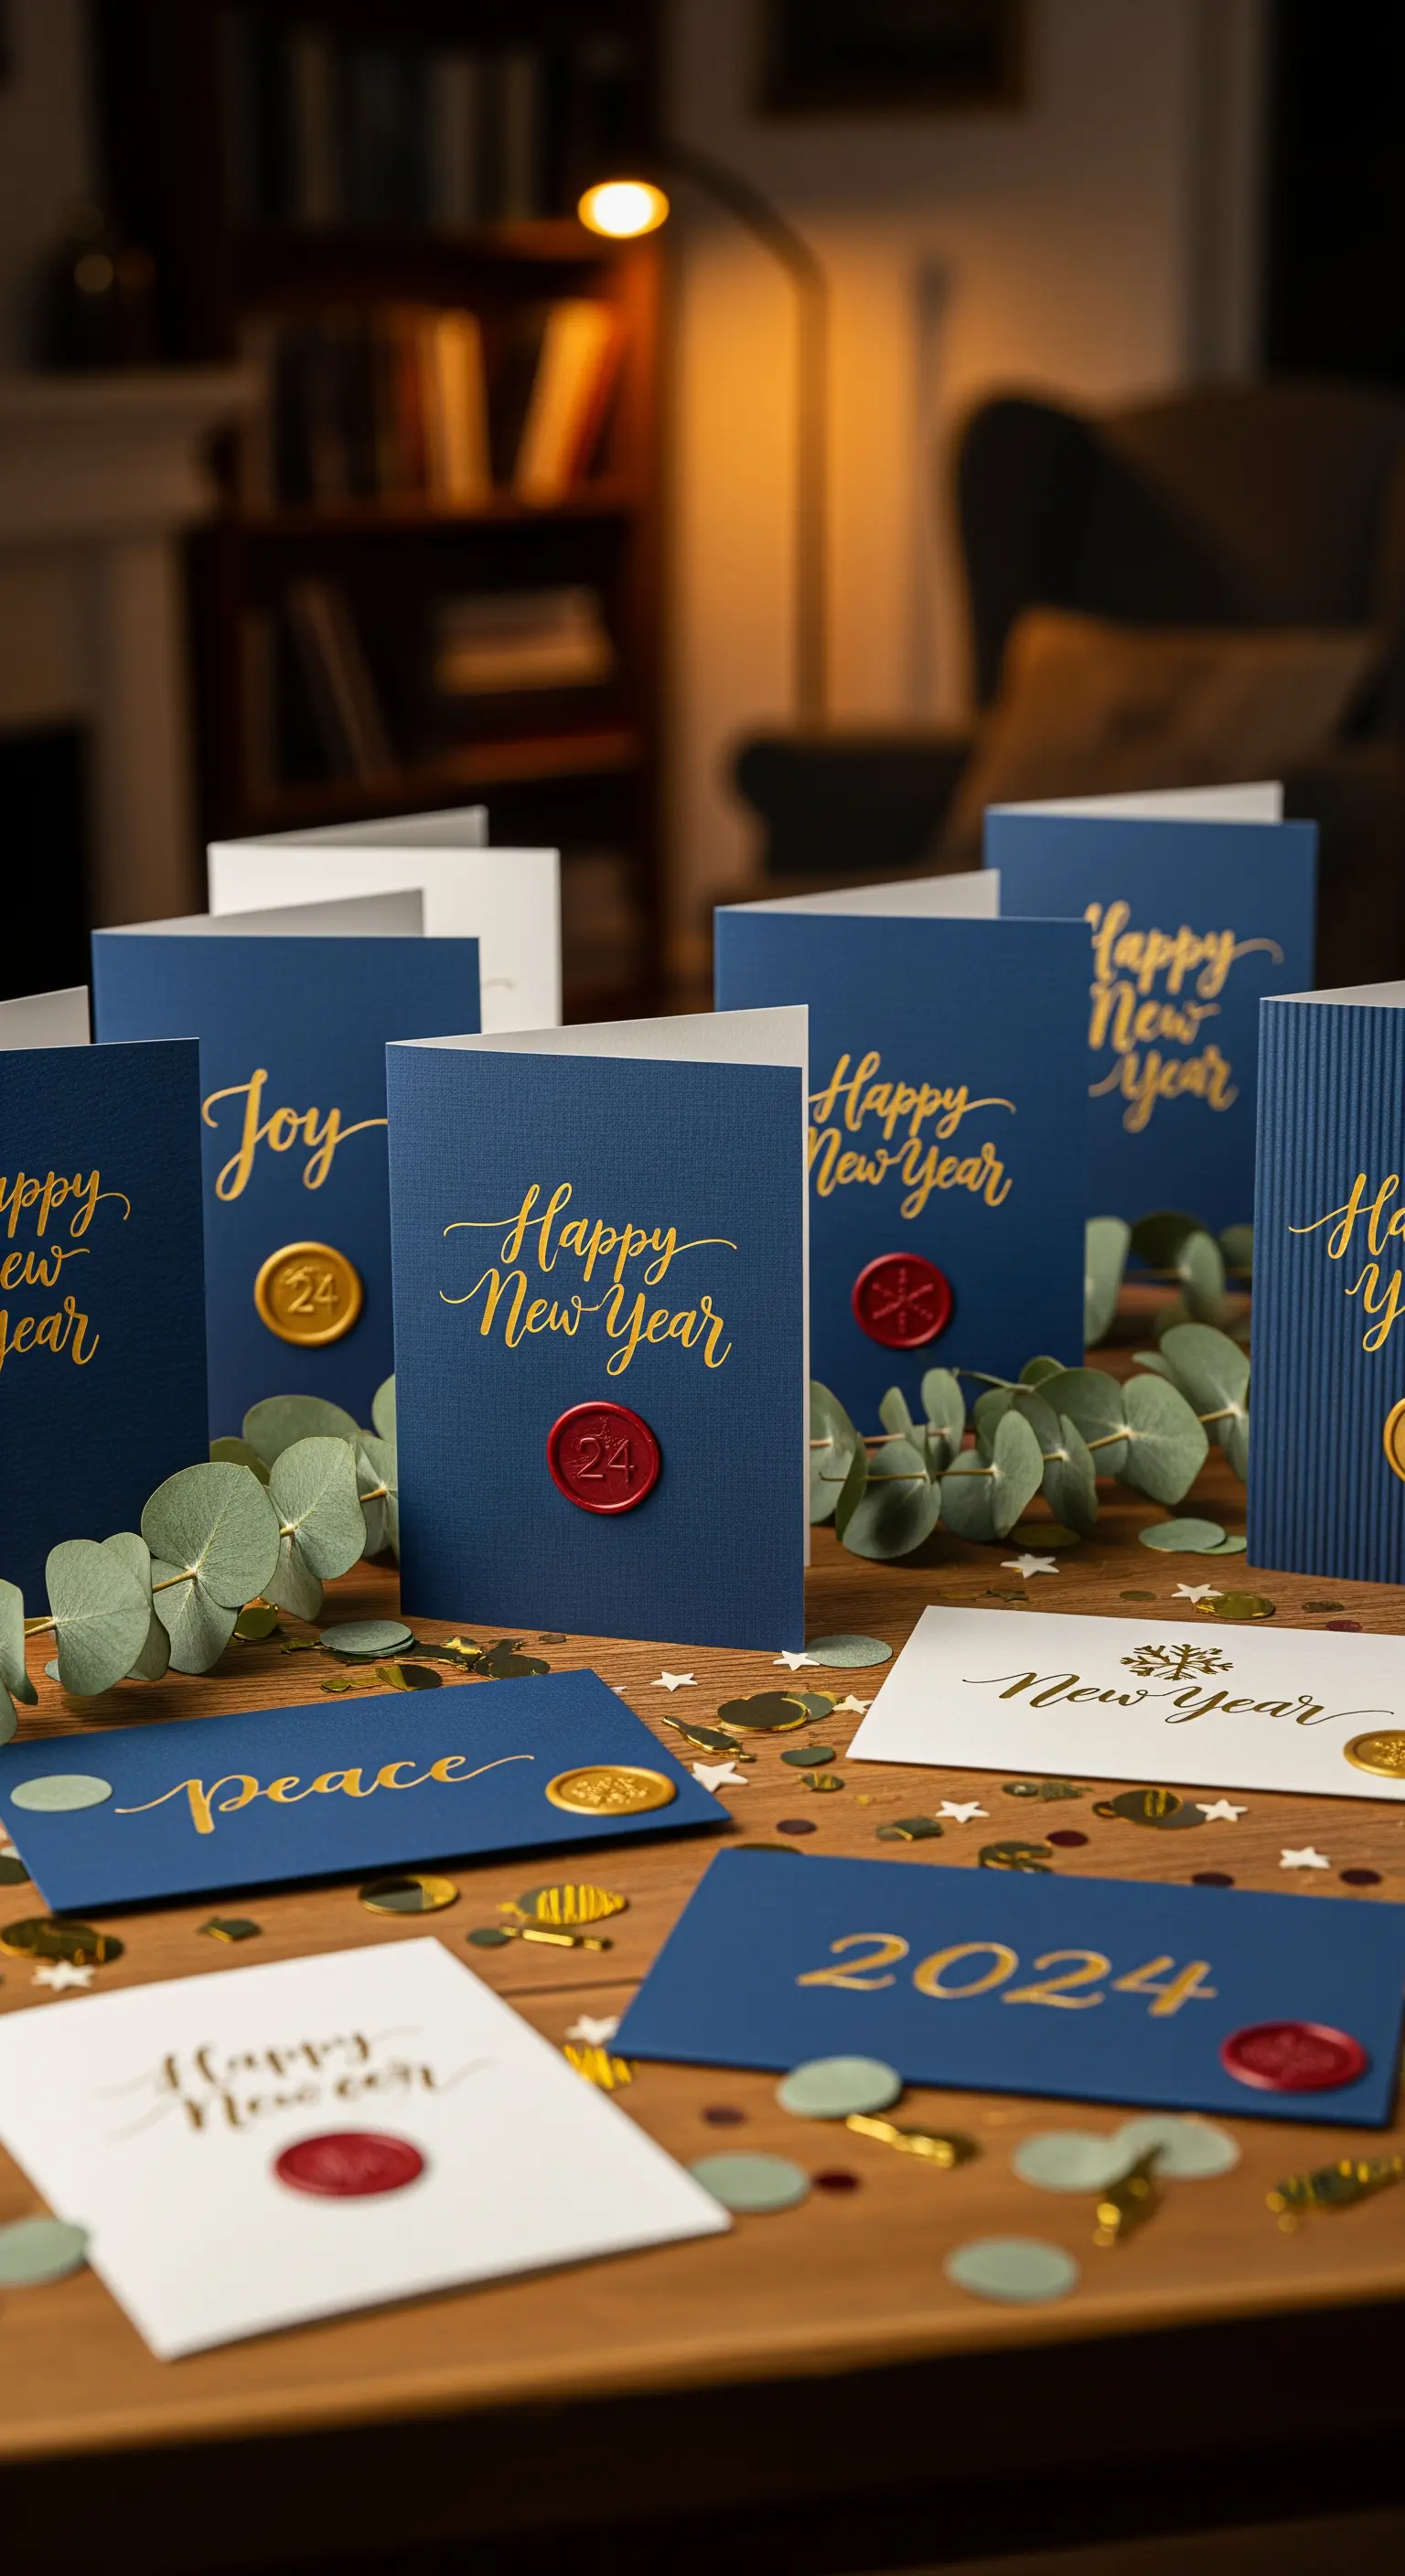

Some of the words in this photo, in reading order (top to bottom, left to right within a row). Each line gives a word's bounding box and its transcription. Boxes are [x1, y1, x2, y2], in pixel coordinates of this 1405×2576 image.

[1089, 980, 1221, 1052] New
[809, 1051, 1016, 1140] Happy
[1089, 1044, 1239, 1133] Year
[202, 1068, 389, 1201] Joy
[809, 1126, 894, 1197] New
[894, 1137, 1013, 1219] Year
[444, 1183, 737, 1285] Happy
[285, 1272, 338, 1315] 24
[439, 1268, 596, 1347] New
[595, 1283, 732, 1376] Year
[576, 1437, 635, 1483] 24
[962, 1672, 1164, 1708] New
[1164, 1686, 1395, 1725] Year
[798, 1932, 1217, 2016] 2024
